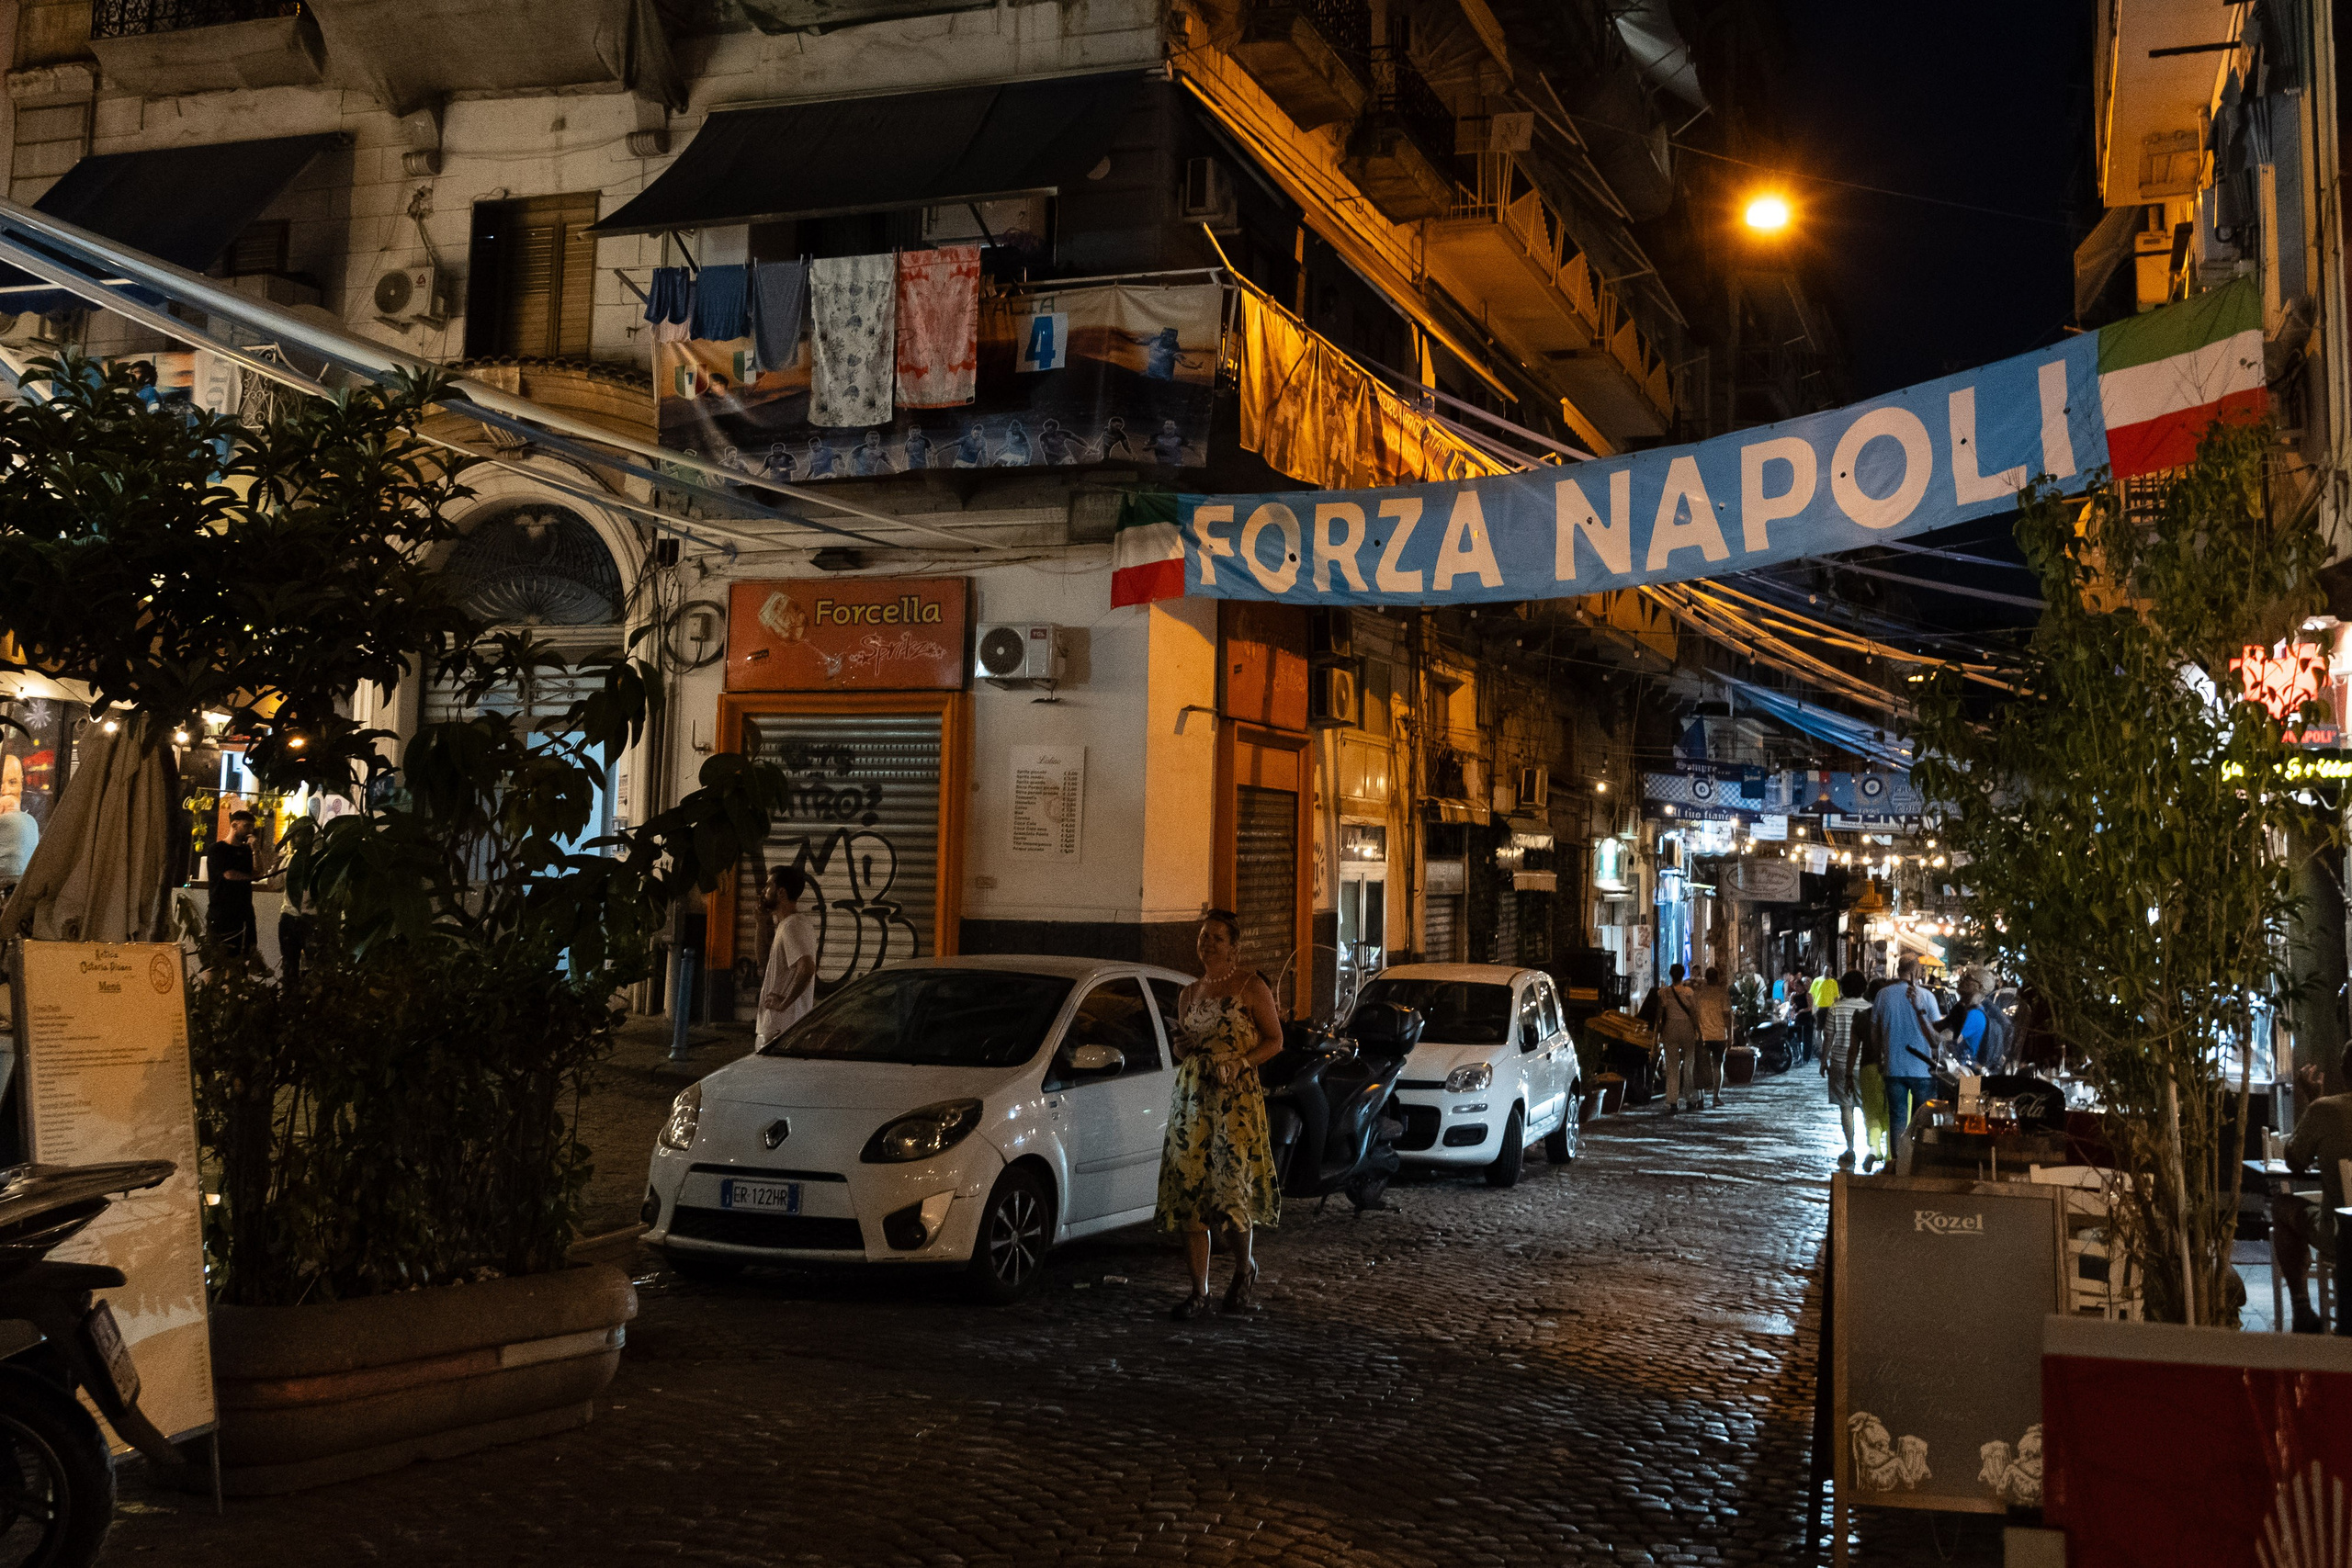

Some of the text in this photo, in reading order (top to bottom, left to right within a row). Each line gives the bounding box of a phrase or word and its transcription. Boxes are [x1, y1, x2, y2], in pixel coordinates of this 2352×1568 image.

[1024, 316, 1056, 369] 4
[1193, 358, 2076, 594] FORZA NAPOLI
[814, 594, 944, 626] Forcella
[860, 631, 930, 677] Spritz
[752, 1188, 787, 1206] 122HR
[1914, 1210, 1984, 1235] Kozel
